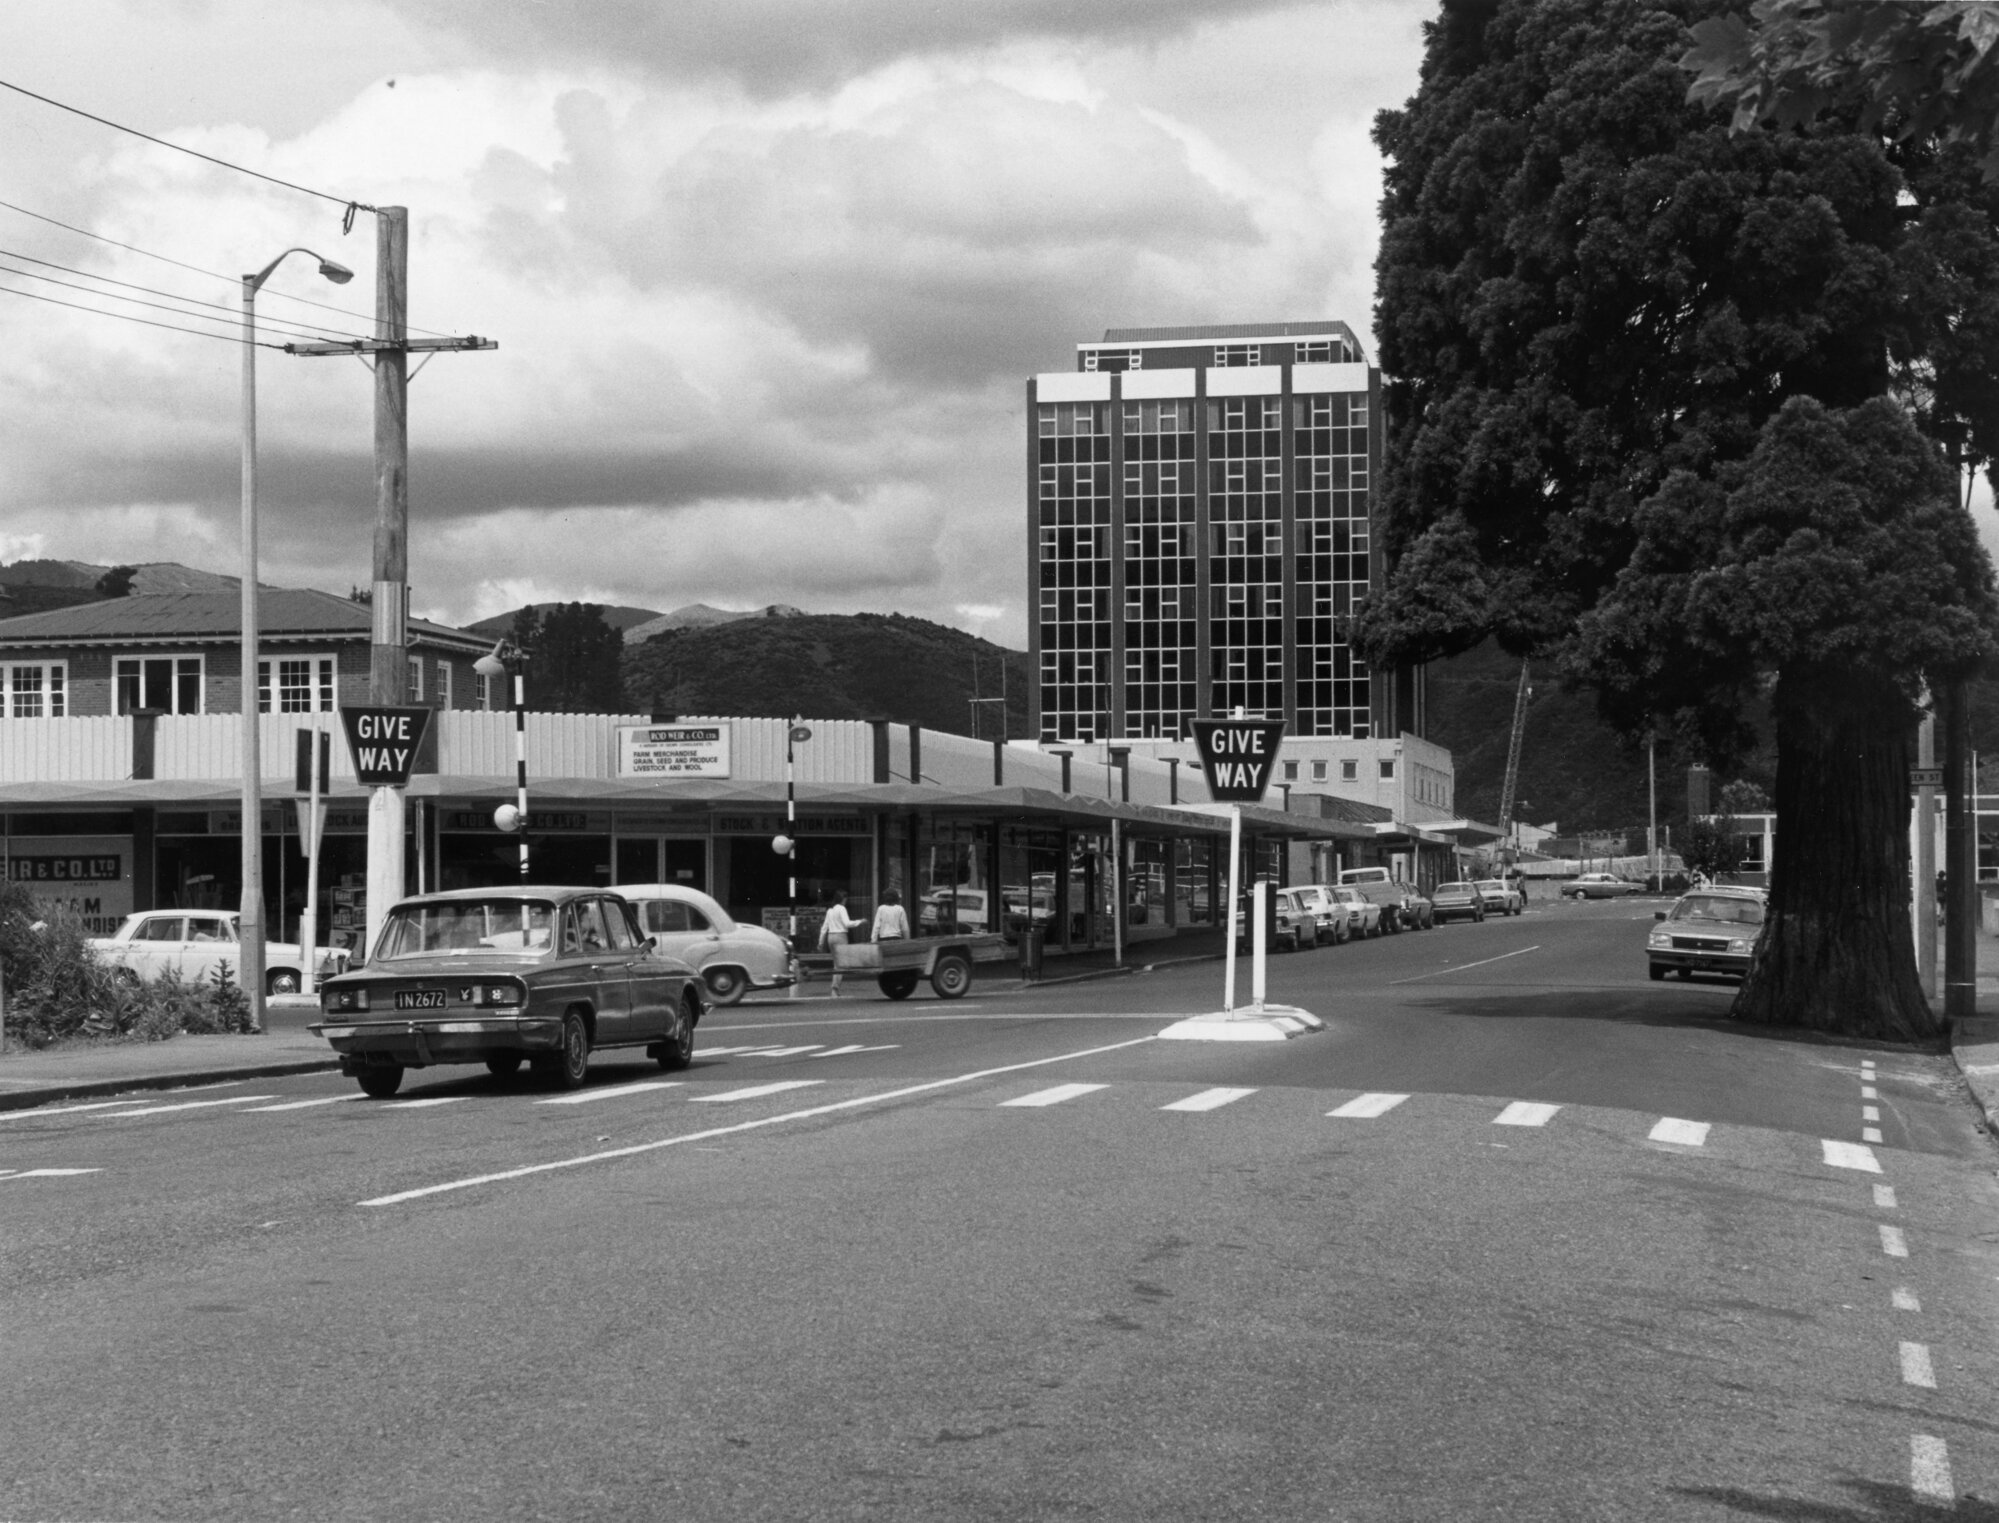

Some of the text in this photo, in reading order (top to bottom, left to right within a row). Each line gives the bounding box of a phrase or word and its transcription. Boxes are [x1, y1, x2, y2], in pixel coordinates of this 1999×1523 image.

[358, 715, 412, 740] GIVE
[651, 732, 667, 740] ROD
[668, 731, 685, 740] WEIR
[1211, 729, 1266, 754] GIVE
[358, 747, 409, 772] WAY
[633, 764, 666, 772] LIVESTOCK
[1215, 763, 1263, 788] WAY
[719, 818, 754, 830] STOCK
[826, 818, 867, 831] AGENTS
[37, 863, 48, 878] &
